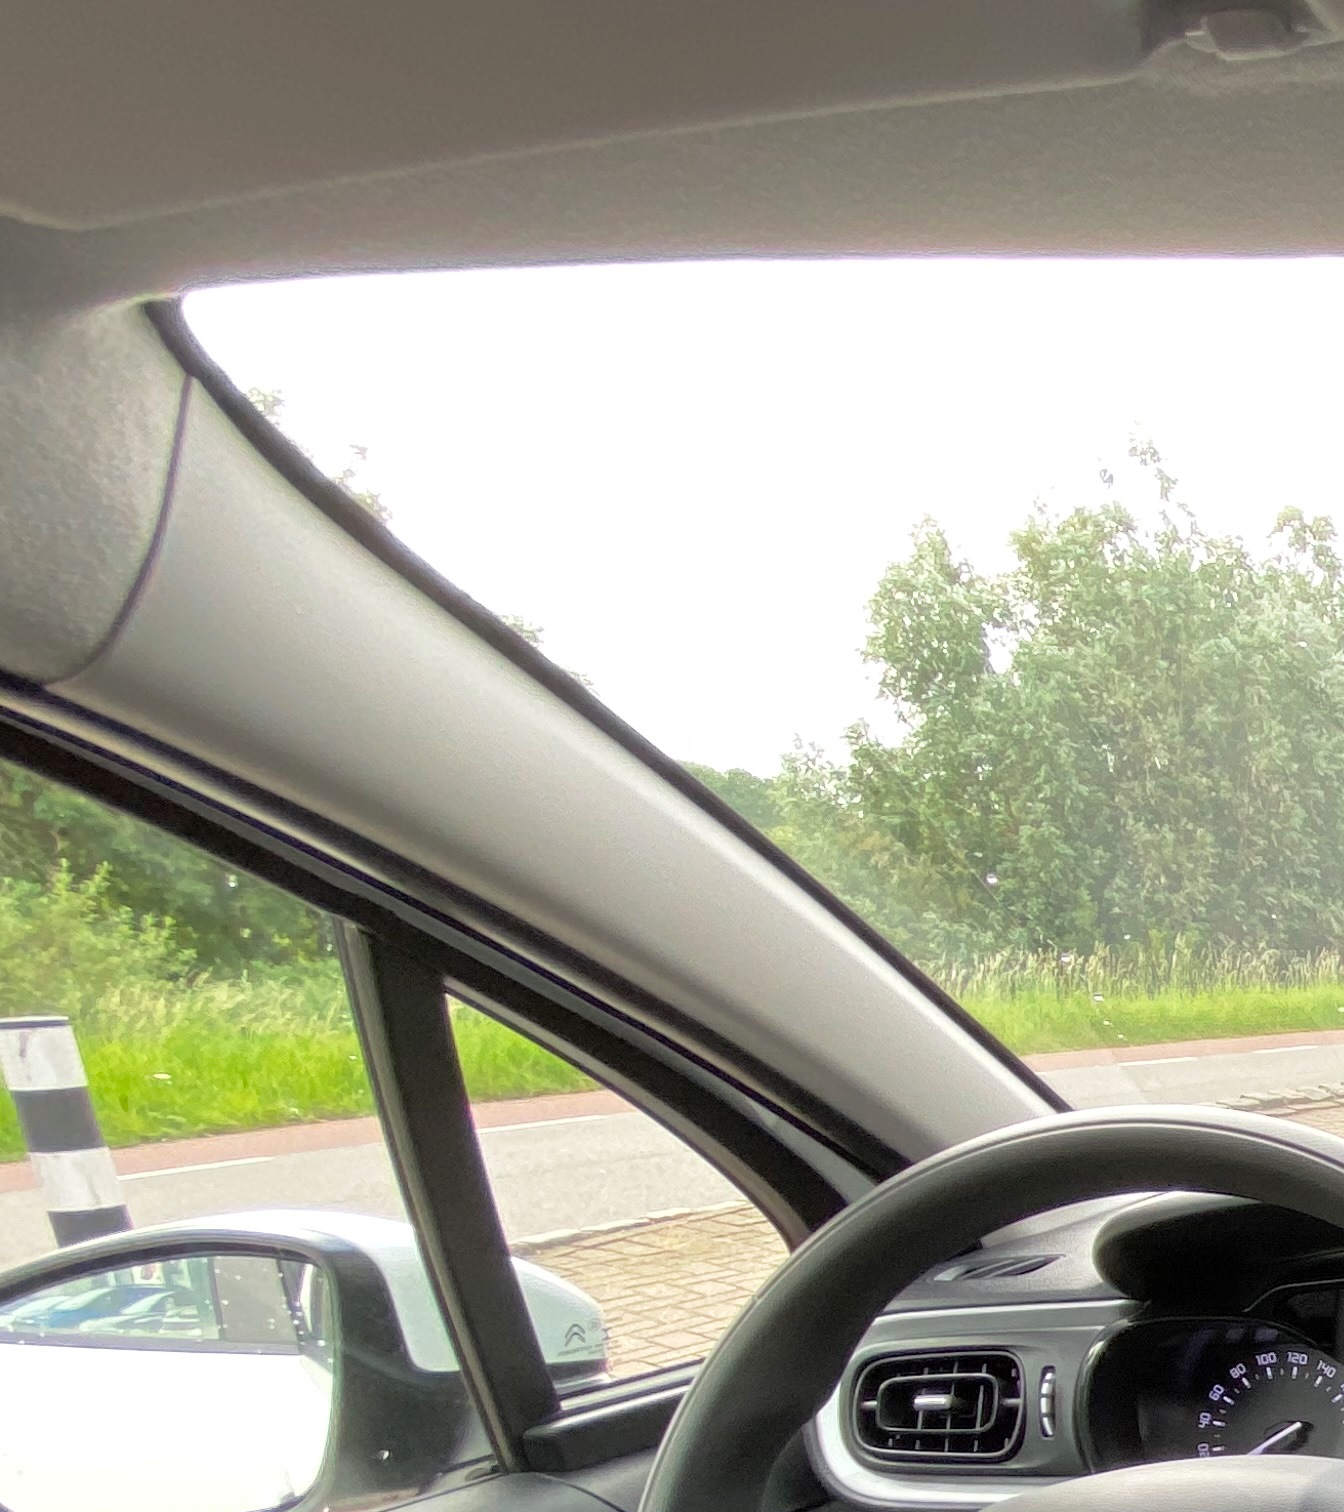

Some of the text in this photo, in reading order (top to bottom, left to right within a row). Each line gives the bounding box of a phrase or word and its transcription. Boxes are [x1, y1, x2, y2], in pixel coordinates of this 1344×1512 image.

[1255, 1352, 1308, 1366] 100 120
[1230, 1363, 1247, 1379] 80
[1317, 1360, 1337, 1379] 140
[1208, 1383, 1225, 1401] 60
[1198, 1412, 1211, 1429] 40
